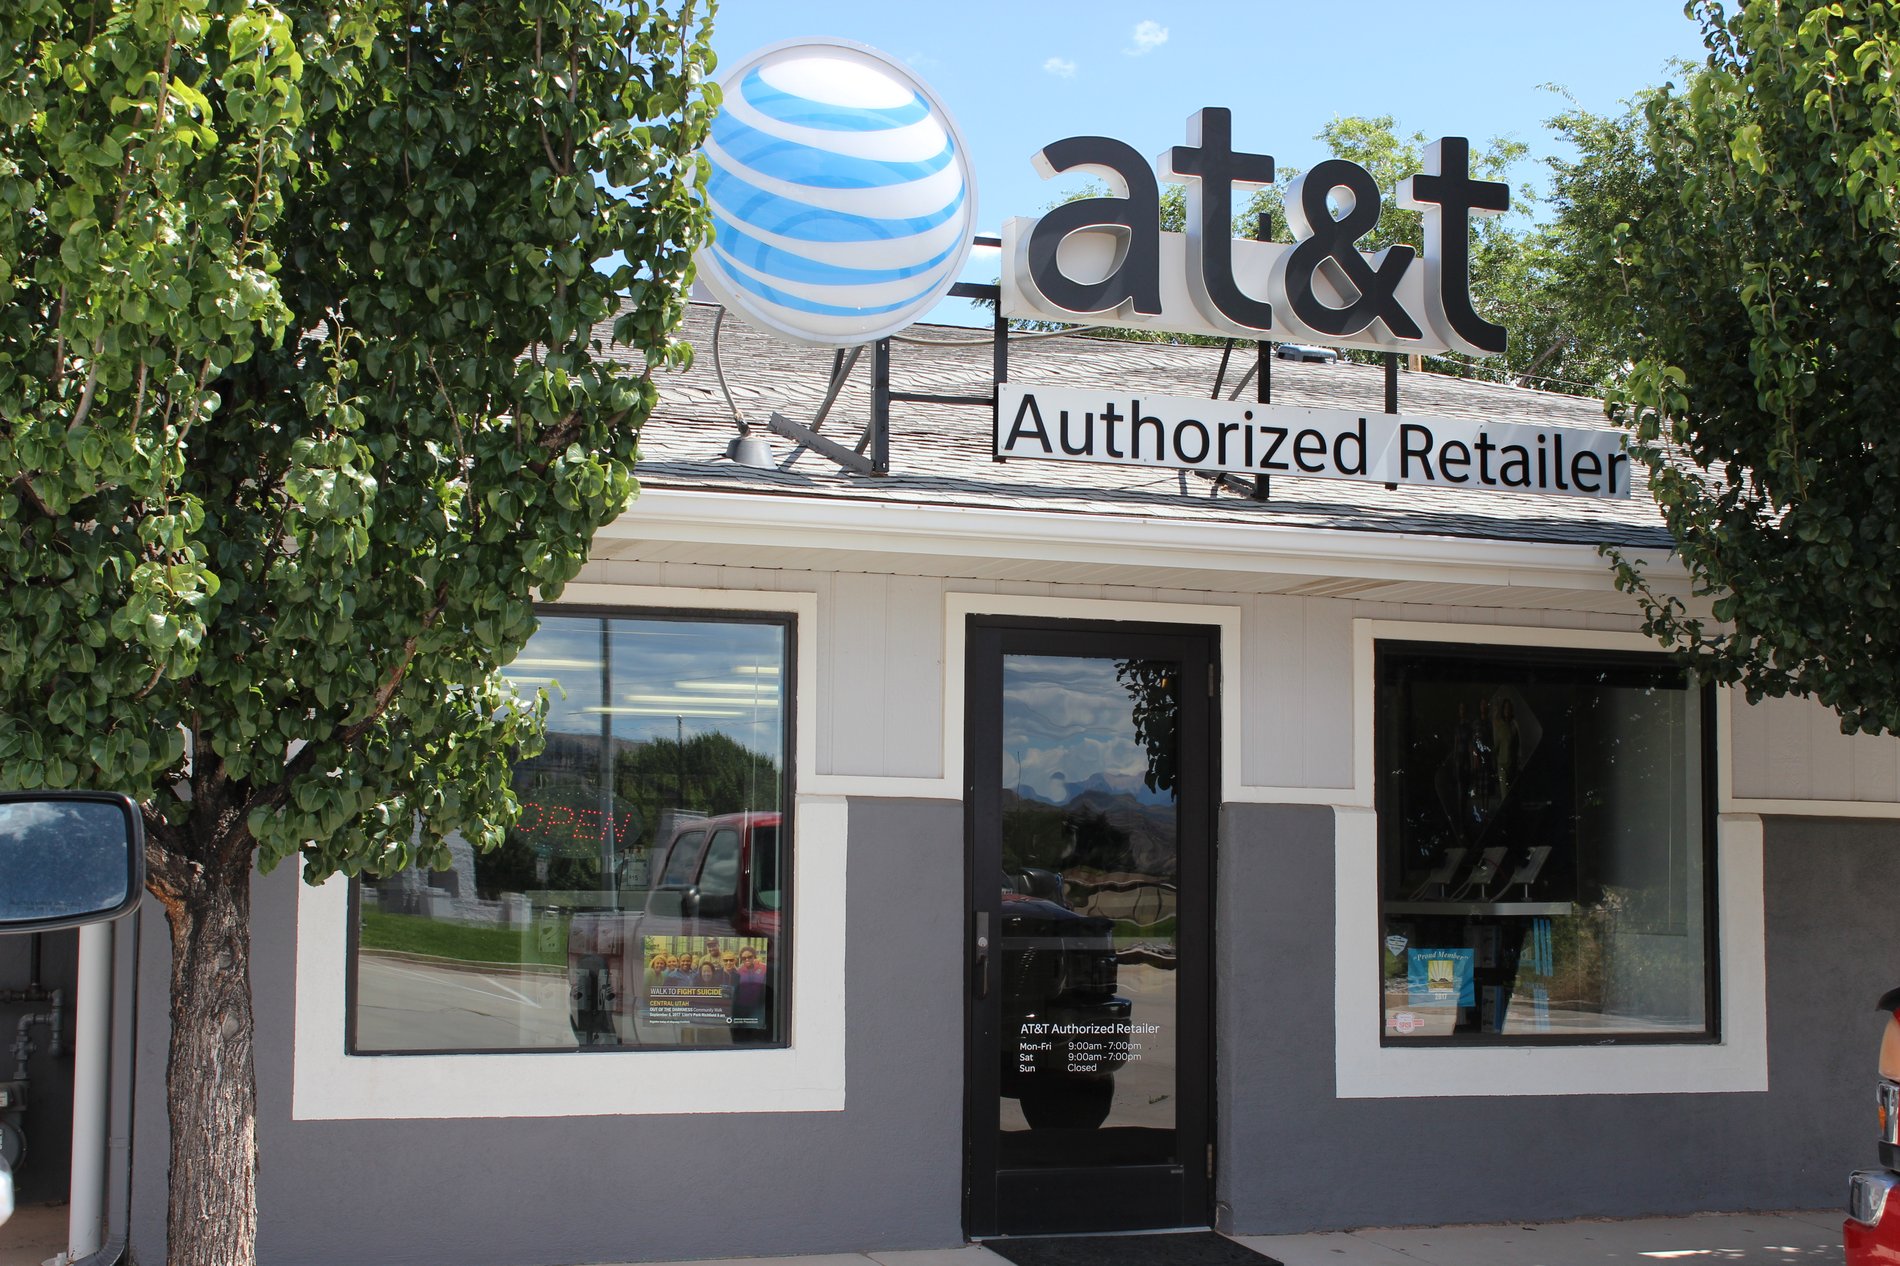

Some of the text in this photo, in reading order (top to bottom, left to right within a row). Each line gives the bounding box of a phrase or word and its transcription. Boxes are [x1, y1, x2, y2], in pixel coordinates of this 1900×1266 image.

[1025, 107, 1510, 355] at&t
[1004, 392, 1627, 494] Authorized Retailer
[516, 803, 631, 842] OPEN
[1417, 951, 1464, 961] Proud Member
[1020, 1023, 1160, 1034] AT&T Authorized Retailer
[1019, 1042, 1052, 1051] Mon-Fri
[1068, 1042, 1102, 1050] 9:00am
[1108, 1042, 1141, 1052] 7:00pm
[1019, 1053, 1033, 1062] Sat
[1068, 1052, 1102, 1061] 9:00am
[1108, 1052, 1141, 1063] 7:00pm
[1019, 1063, 1097, 1073] Sun Closed
